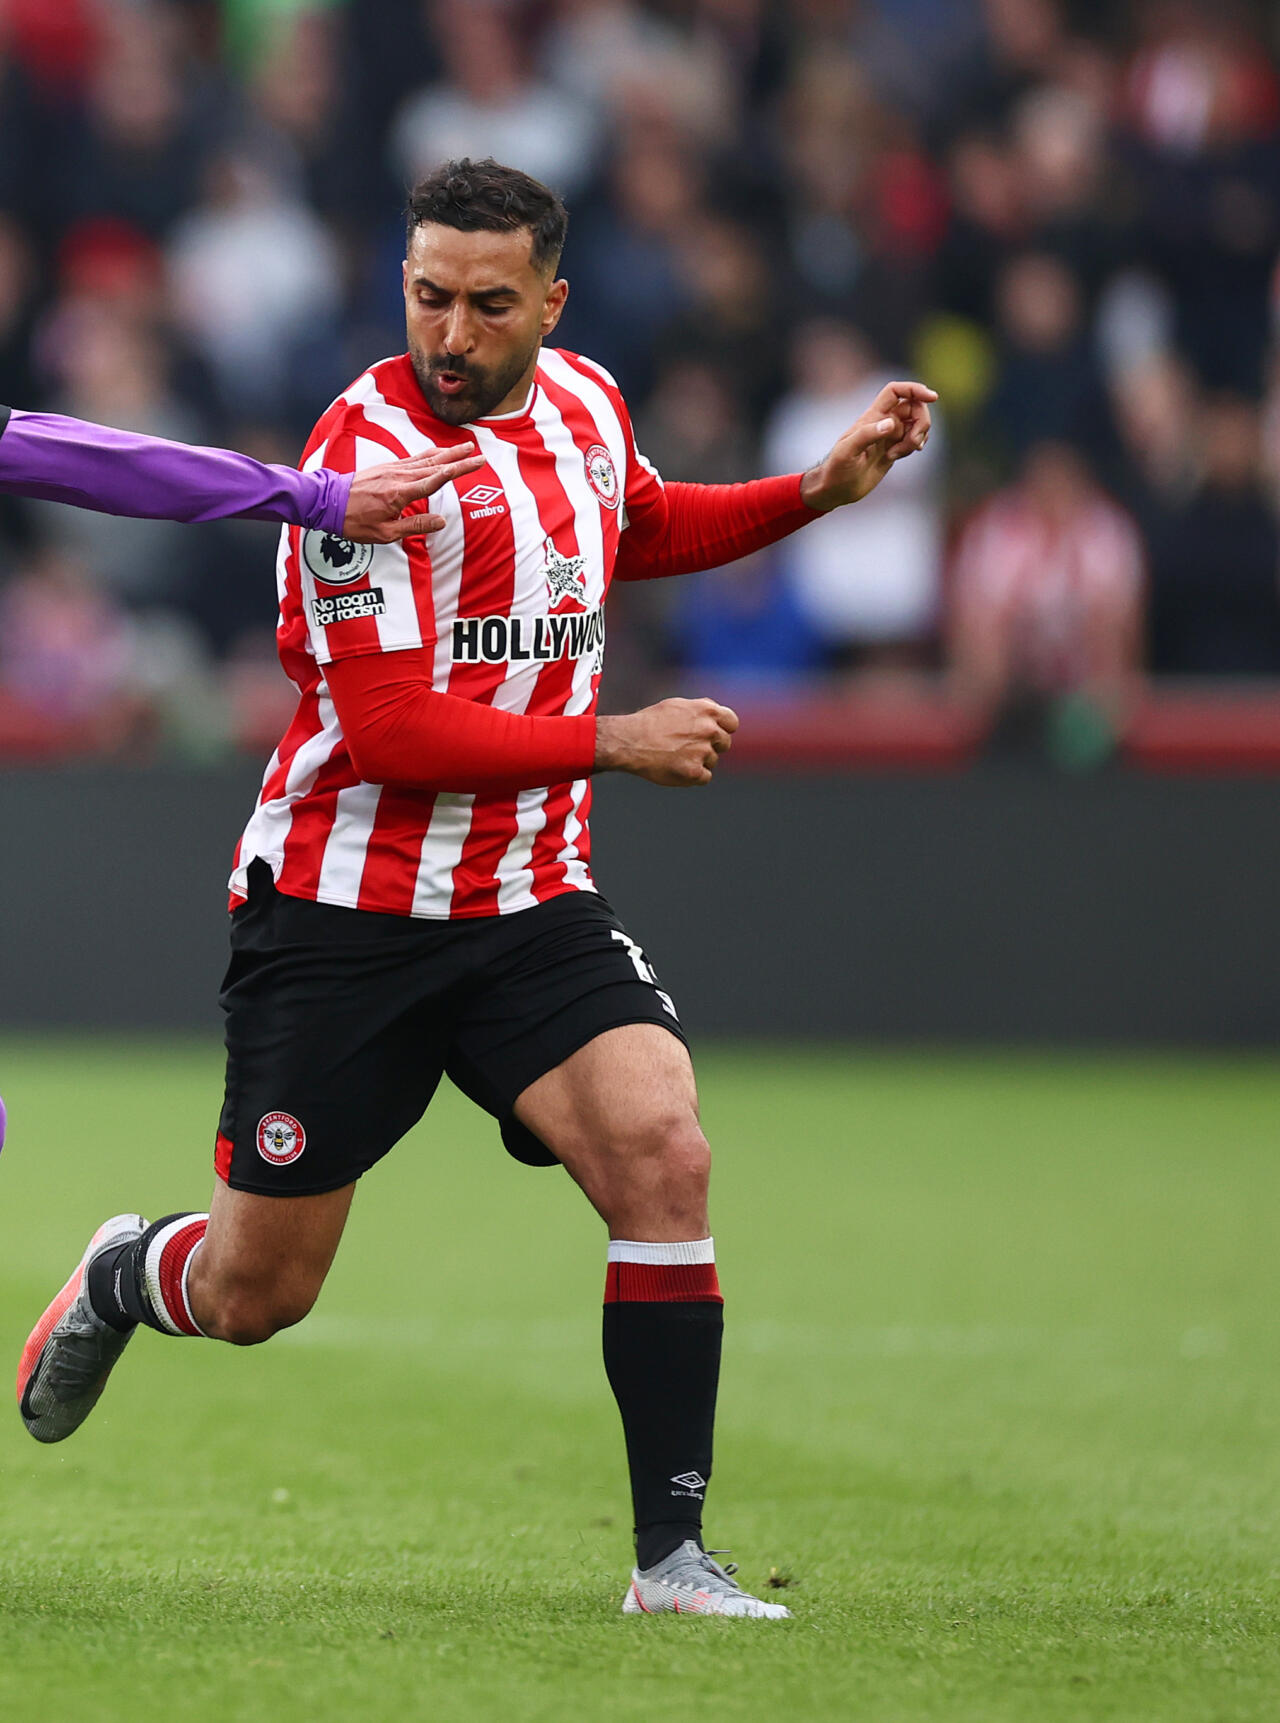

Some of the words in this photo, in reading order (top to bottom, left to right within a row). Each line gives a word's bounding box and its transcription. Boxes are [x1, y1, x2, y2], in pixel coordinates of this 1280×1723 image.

[470, 505, 505, 519] umbro
[312, 599, 334, 613] No
[336, 591, 377, 609] room
[314, 611, 335, 626] for
[337, 602, 386, 621] racism
[452, 610, 604, 661] HOLLYWOO
[262, 1114, 298, 1129] BRENTFORD
